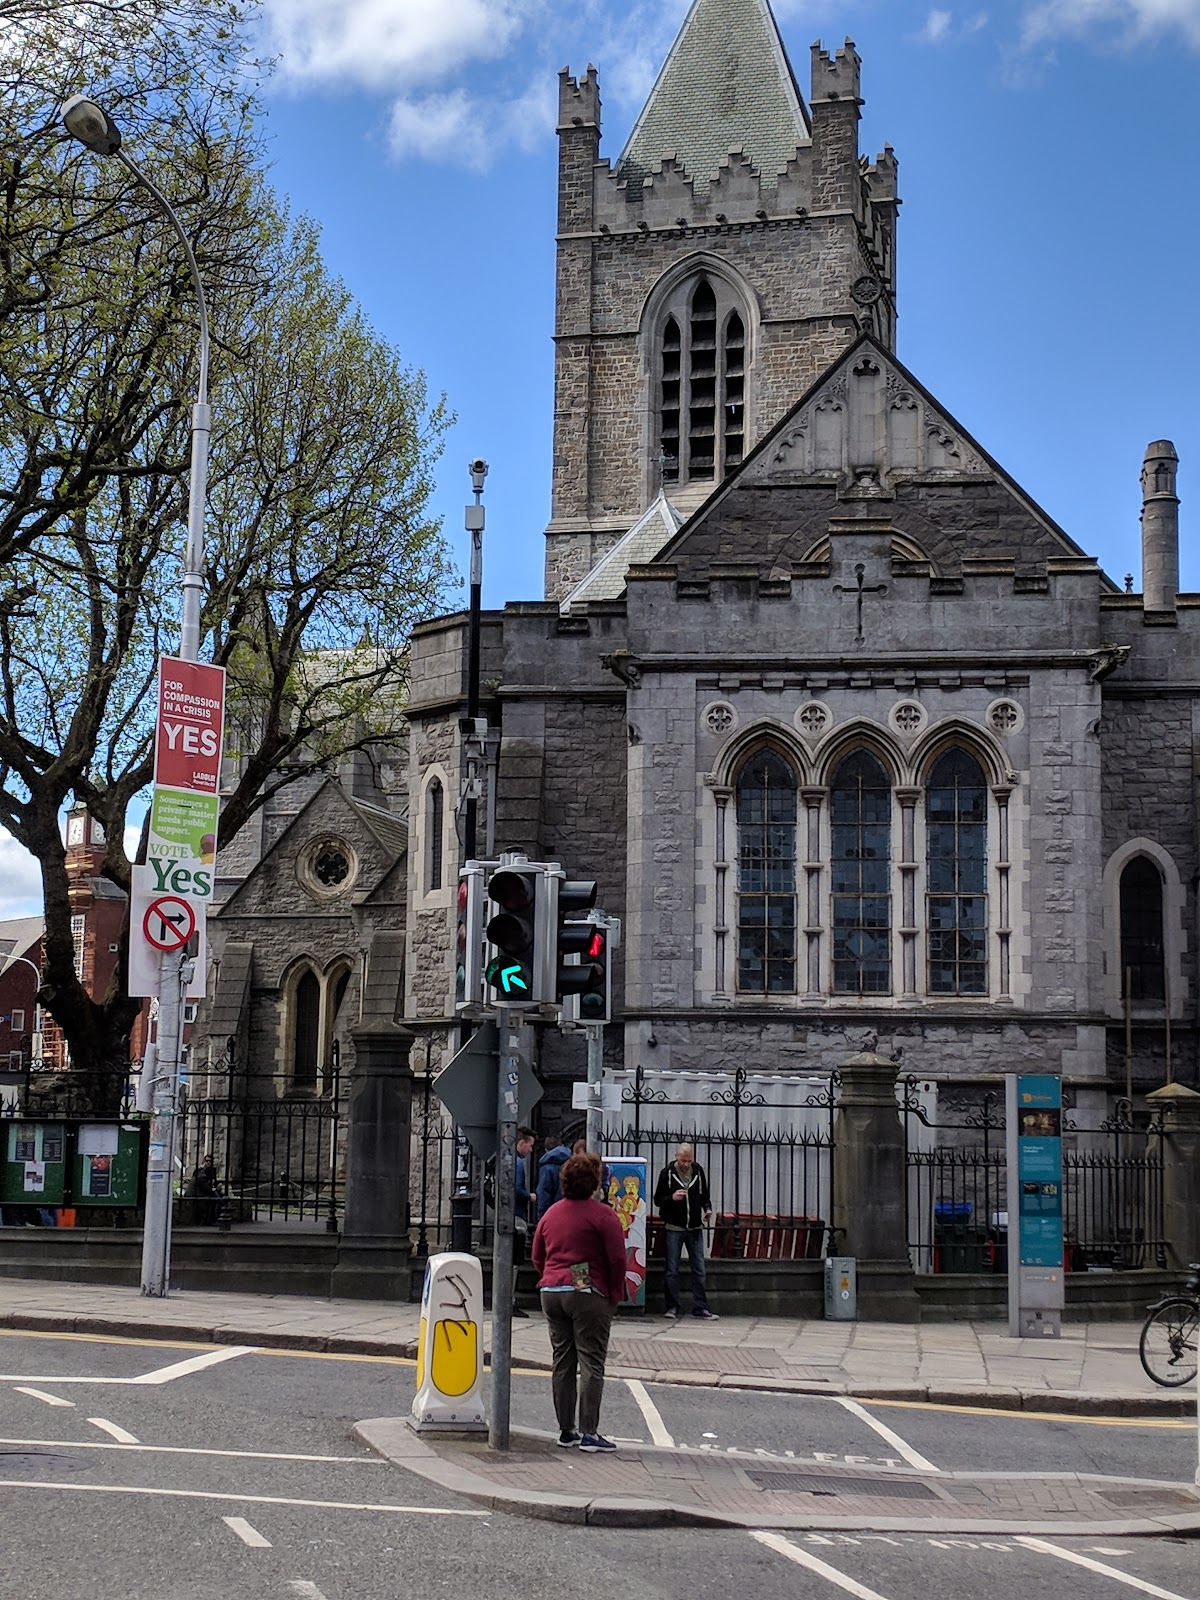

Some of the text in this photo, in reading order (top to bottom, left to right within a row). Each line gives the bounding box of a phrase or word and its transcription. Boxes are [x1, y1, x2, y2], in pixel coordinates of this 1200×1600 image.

[164, 680, 183, 691] FOR
[164, 691, 220, 709] COMPASSION
[164, 702, 211, 718] IN A CRISIS
[163, 722, 217, 757] YES
[193, 772, 216, 782] LABOUR
[159, 795, 203, 808] Sometimes
[159, 806, 215, 819] private matter
[157, 815, 207, 828] needs public
[156, 825, 191, 835] support.
[150, 843, 189, 859] VOTE
[149, 858, 211, 896] Yes
